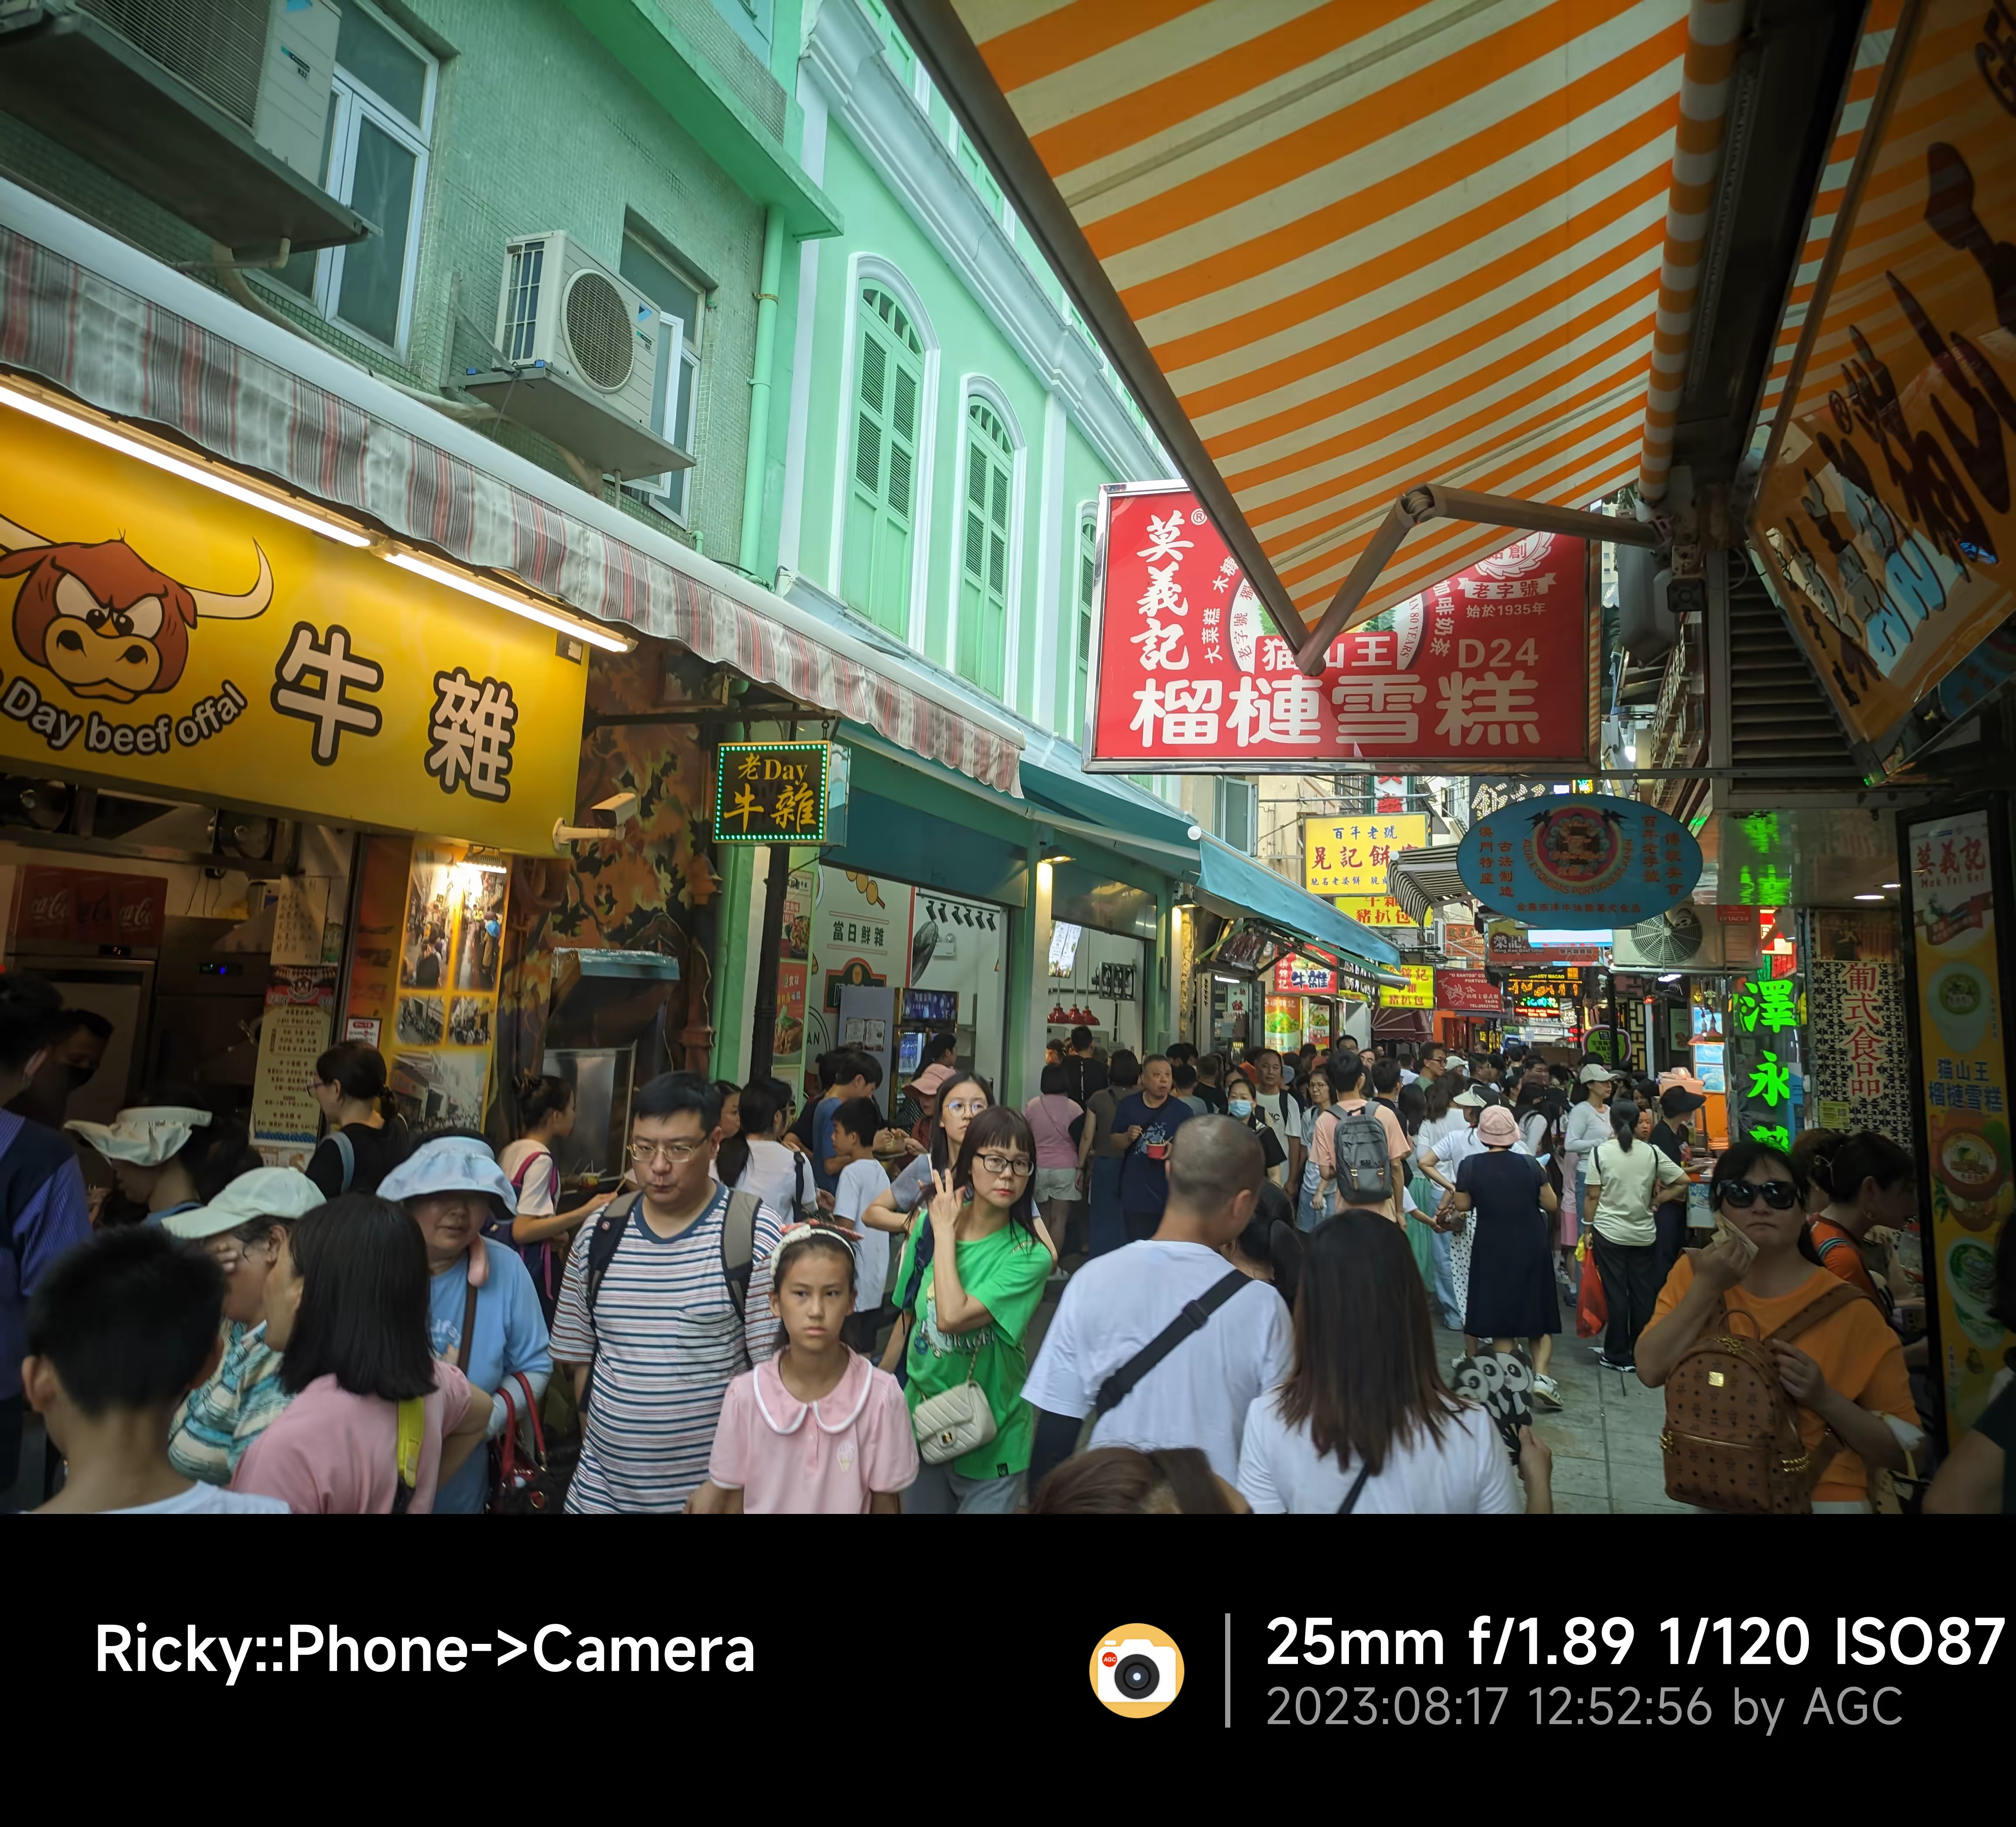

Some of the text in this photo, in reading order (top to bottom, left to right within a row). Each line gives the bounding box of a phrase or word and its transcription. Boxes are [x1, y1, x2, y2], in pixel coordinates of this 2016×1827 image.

[1130, 510, 1194, 672] 莫義記
[1472, 580, 1539, 599] 老字號
[1410, 613, 1419, 623] 80
[1430, 579, 1454, 657] 咖啡奶茶
[1466, 602, 1546, 618] 始於1935年
[1202, 608, 1223, 664] 大菜糕
[1234, 613, 1251, 661] 老字號
[1400, 626, 1418, 658] YEARS
[1459, 637, 1539, 668] D24
[2, 677, 246, 755] Day beef offal
[271, 622, 518, 802] 牛雜
[1130, 671, 1541, 748] 榴槤雪糕
[738, 752, 808, 784] 老Day
[724, 781, 817, 834] 牛雜
[1332, 825, 1398, 840] 百年老號
[1311, 843, 1419, 870] 晃記餅
[1914, 836, 1986, 878] 莫義記
[1534, 869, 1570, 894] COMIDAS
[1356, 909, 1411, 924] 豬扒包
[833, 920, 884, 947] 當日鮮雜
[1494, 935, 1522, 949] 榮記
[1278, 954, 1289, 989] 梁錦記
[1291, 970, 1328, 989] 牛雜
[1389, 995, 1423, 1006] 豬扒包
[1841, 962, 1885, 1097] 葡式食品
[1937, 1058, 1989, 1082] 猫山王
[1928, 1081, 2003, 1112] 榴槤雪糕
